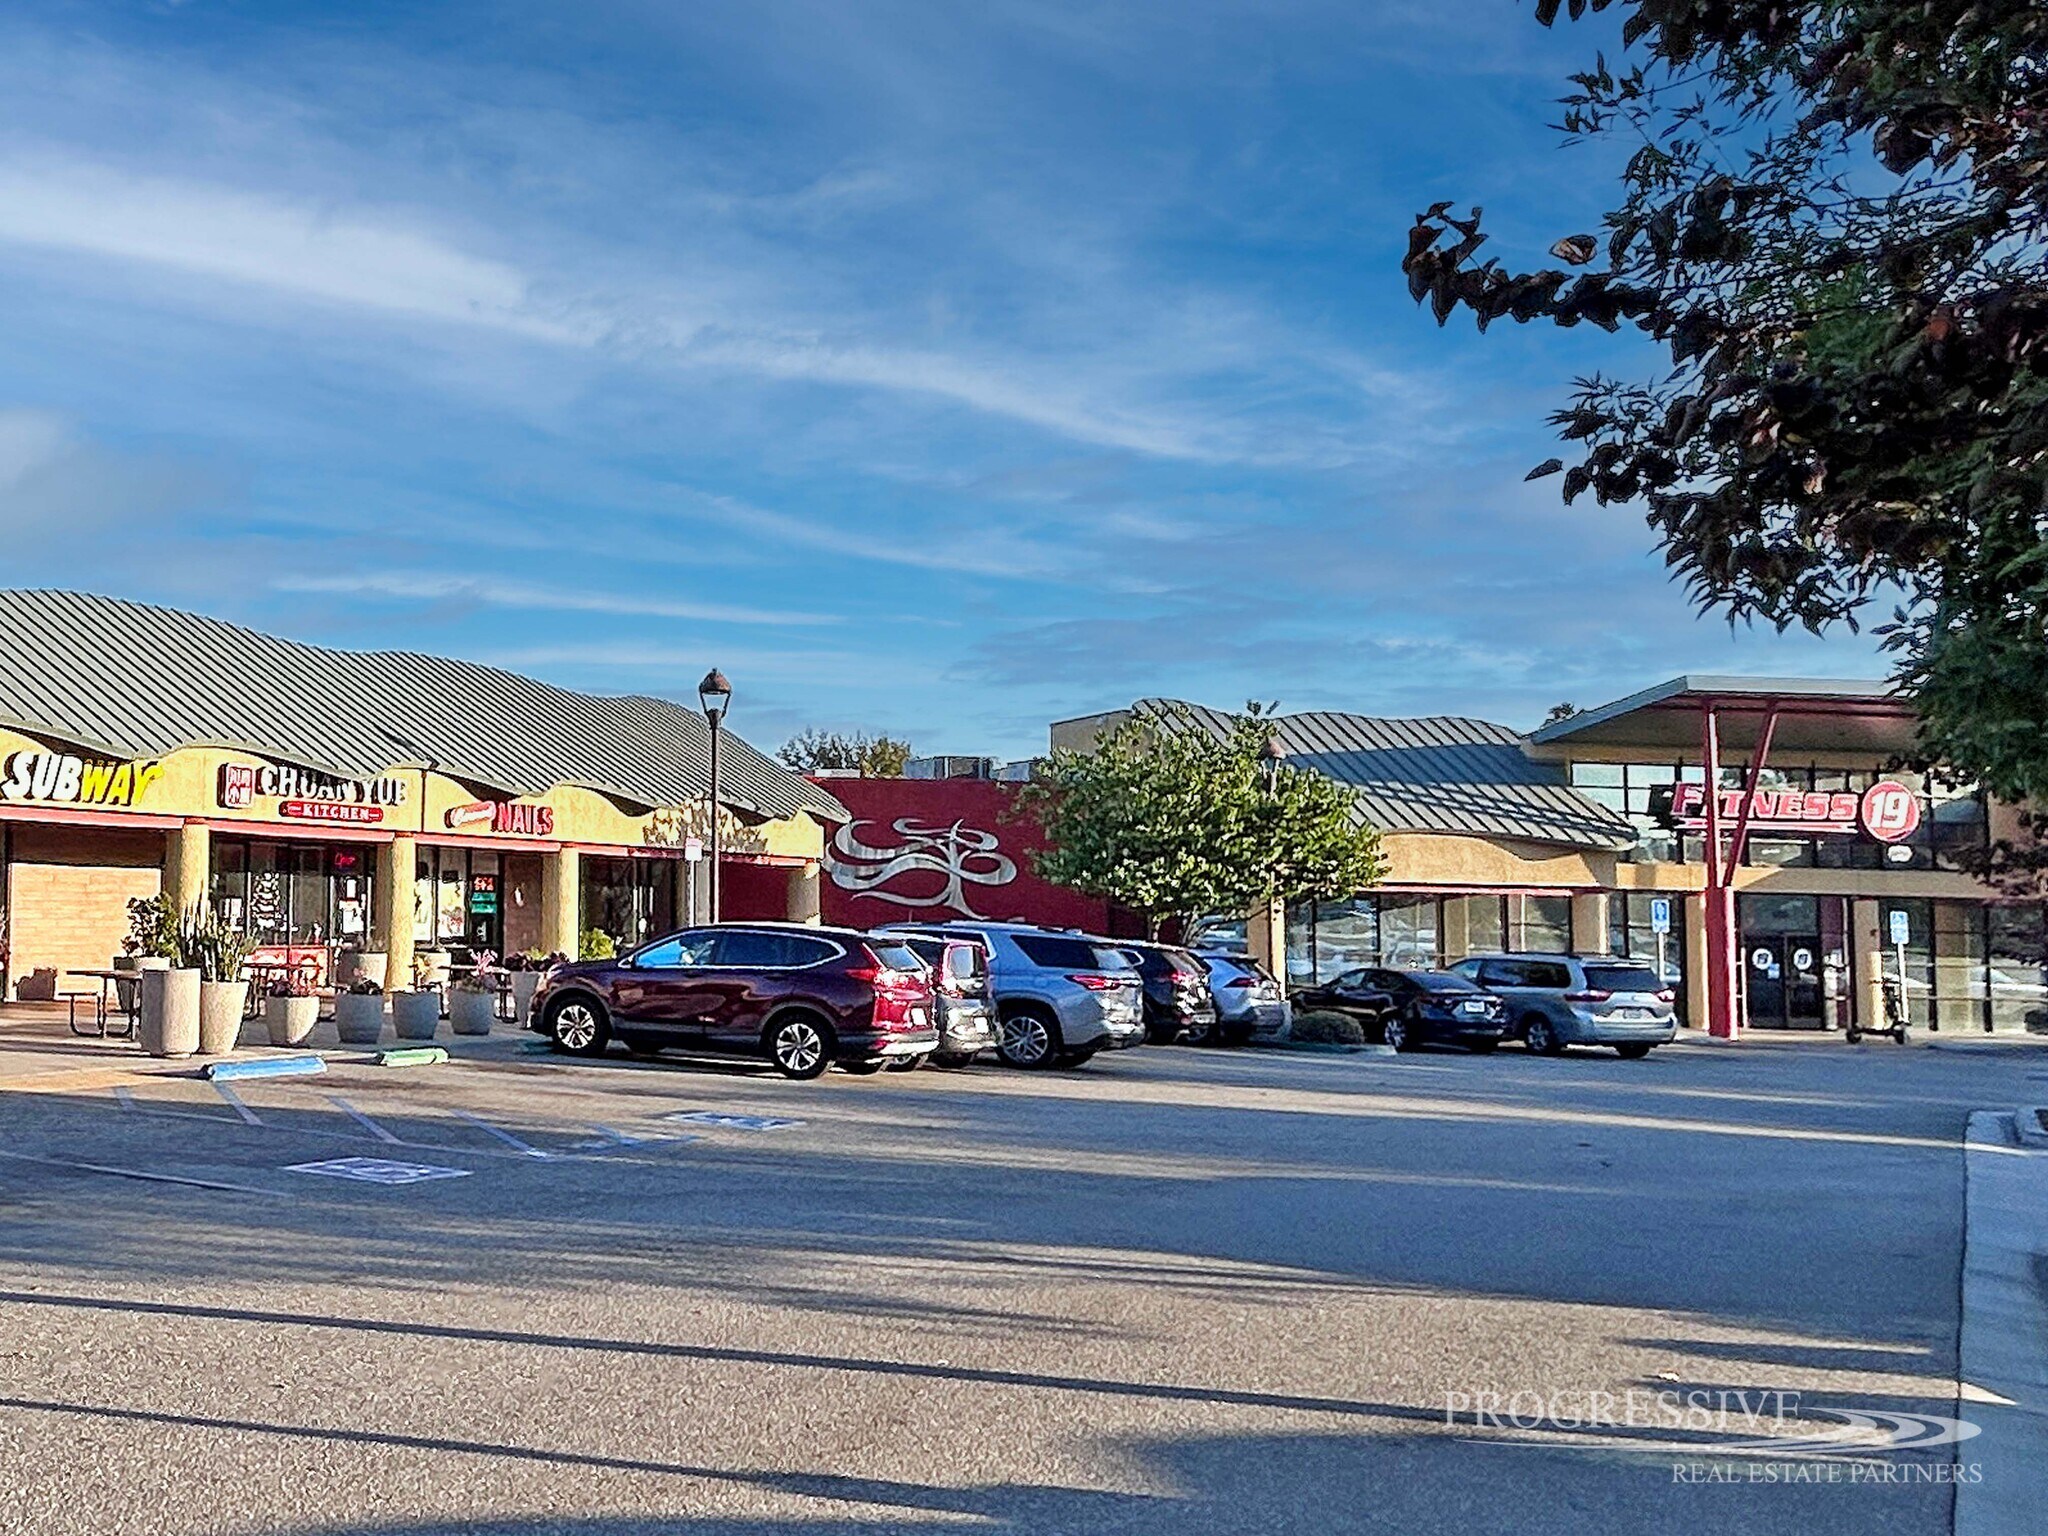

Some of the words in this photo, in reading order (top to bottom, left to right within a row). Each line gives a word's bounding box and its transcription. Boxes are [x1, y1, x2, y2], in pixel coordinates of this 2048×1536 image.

[2, 751, 164, 806] SUBWAY
[302, 803, 370, 820] KITCHEN
[497, 801, 553, 835] NAILS
[1670, 781, 1858, 820] FTNESS
[1869, 791, 1910, 829] 19
